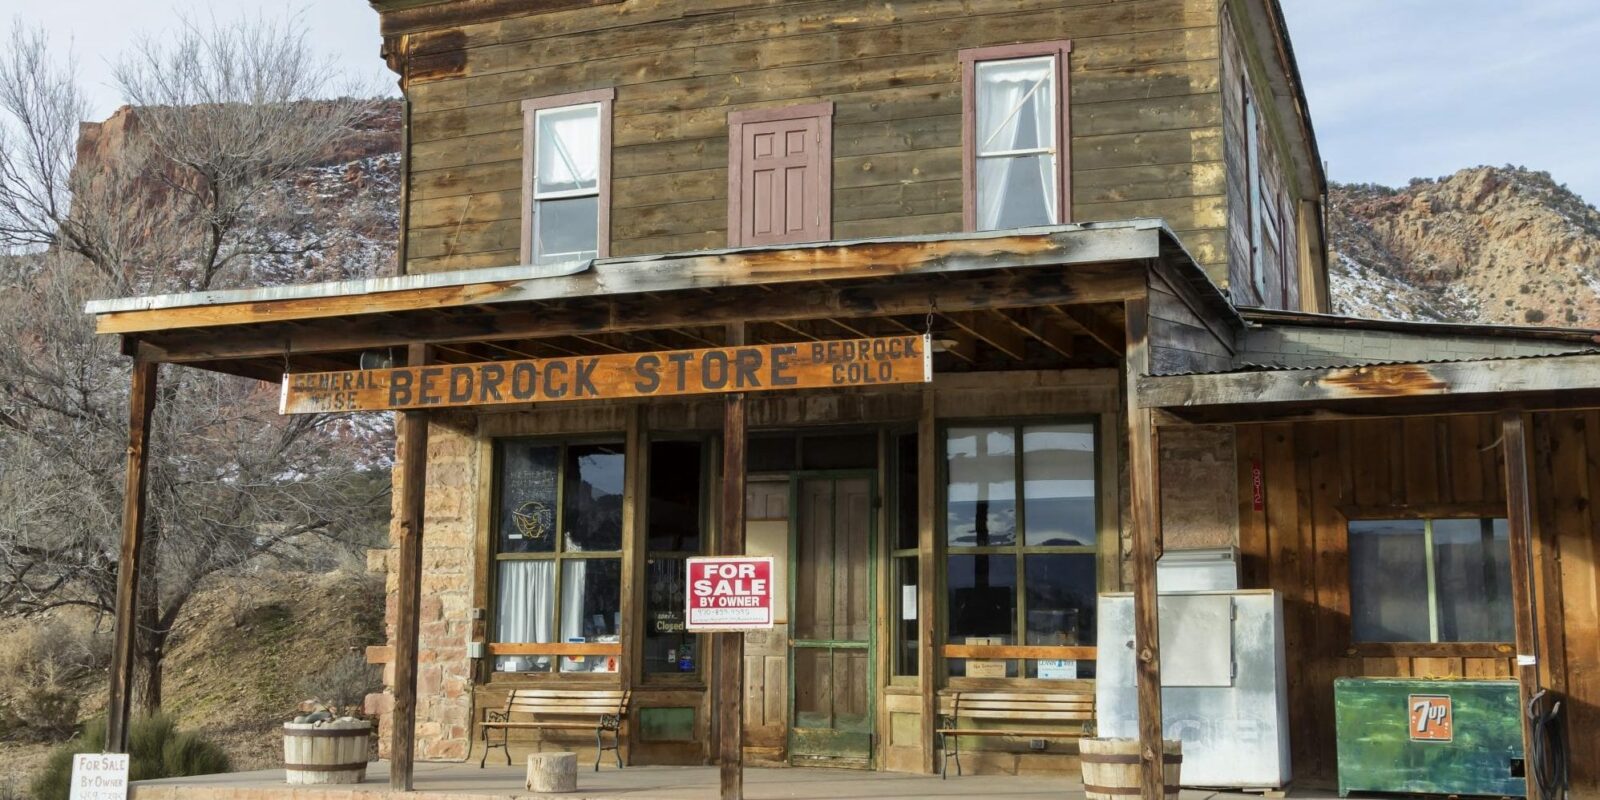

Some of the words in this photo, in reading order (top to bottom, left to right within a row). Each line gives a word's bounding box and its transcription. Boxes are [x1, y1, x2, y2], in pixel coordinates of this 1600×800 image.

[811, 337, 918, 364] BEDROCK
[294, 371, 378, 392] GENERAL
[388, 358, 600, 406] BEDROCK
[634, 344, 798, 393] STORE
[831, 361, 901, 385] COLO.
[703, 563, 756, 579] FOR
[693, 579, 767, 596] SALE
[699, 597, 716, 607] BY
[718, 596, 760, 607] OWNER
[656, 620, 684, 631] Closed
[1413, 700, 1447, 733] 7up
